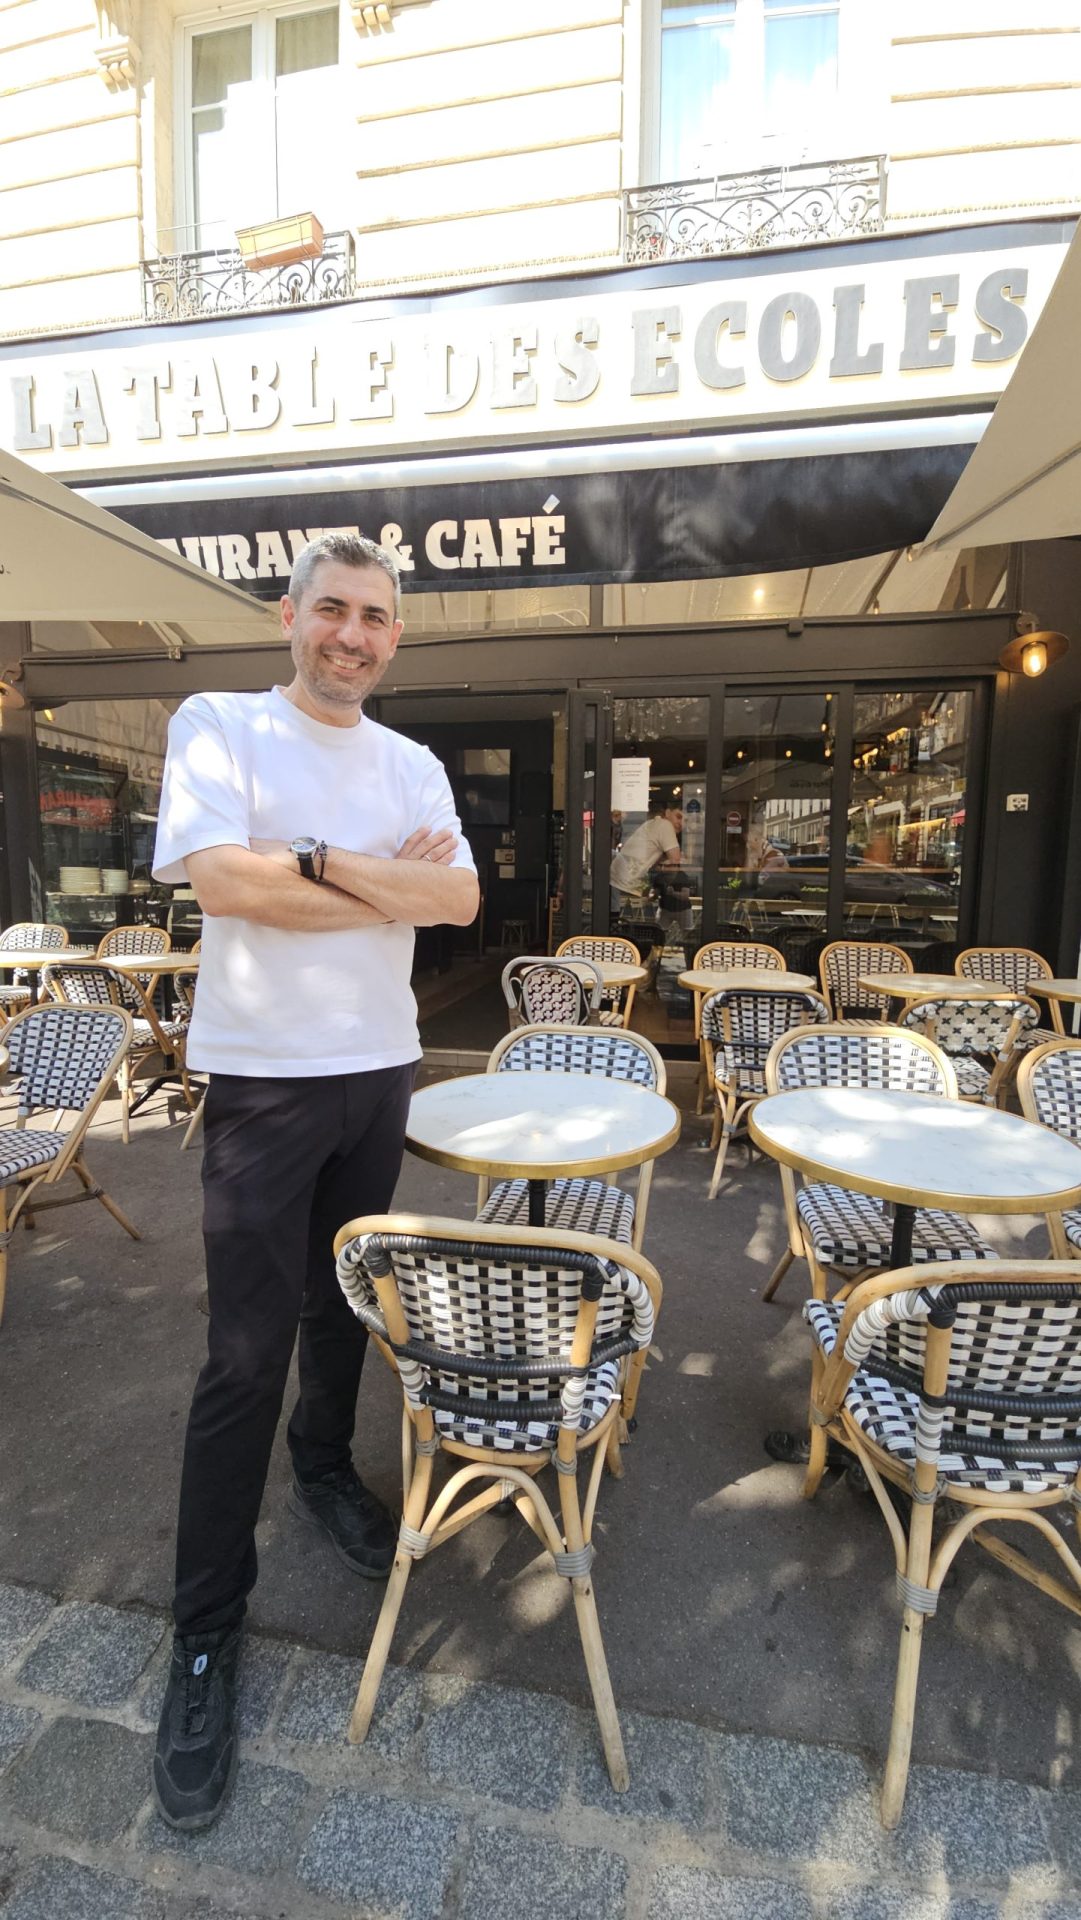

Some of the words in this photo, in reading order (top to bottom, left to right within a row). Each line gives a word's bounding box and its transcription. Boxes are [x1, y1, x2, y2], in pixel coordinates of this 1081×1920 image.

[10, 369, 109, 451] LA
[122, 338, 396, 440] TABLE
[423, 316, 602, 415] DES
[629, 267, 1029, 397] ECOLES
[380, 522, 416, 572] &
[425, 494, 566, 571] CAFÉ
